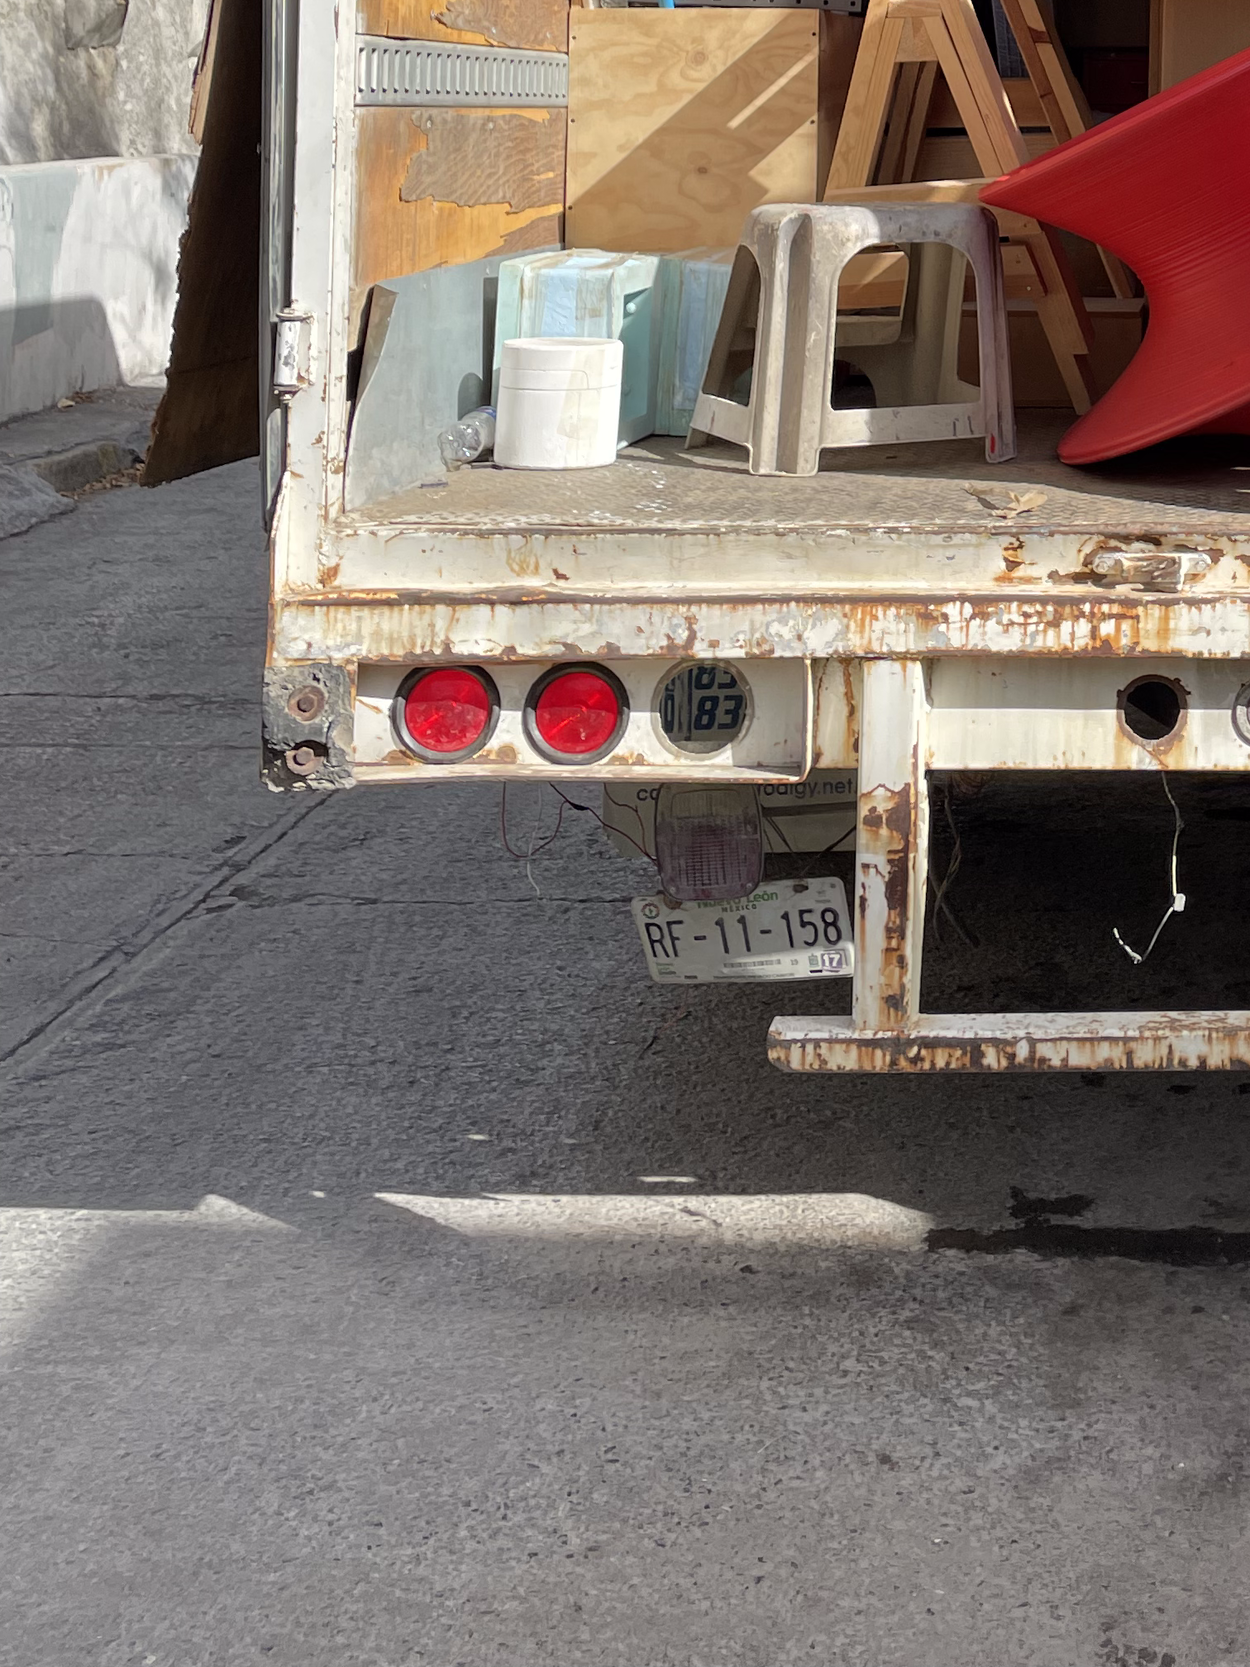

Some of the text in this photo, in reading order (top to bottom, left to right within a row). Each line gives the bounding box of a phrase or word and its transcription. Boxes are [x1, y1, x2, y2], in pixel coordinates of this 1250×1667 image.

[693, 695, 744, 730] 83
[746, 890, 778, 903] León
[644, 906, 843, 958] RF-11-158
[822, 953, 842, 967] 17
